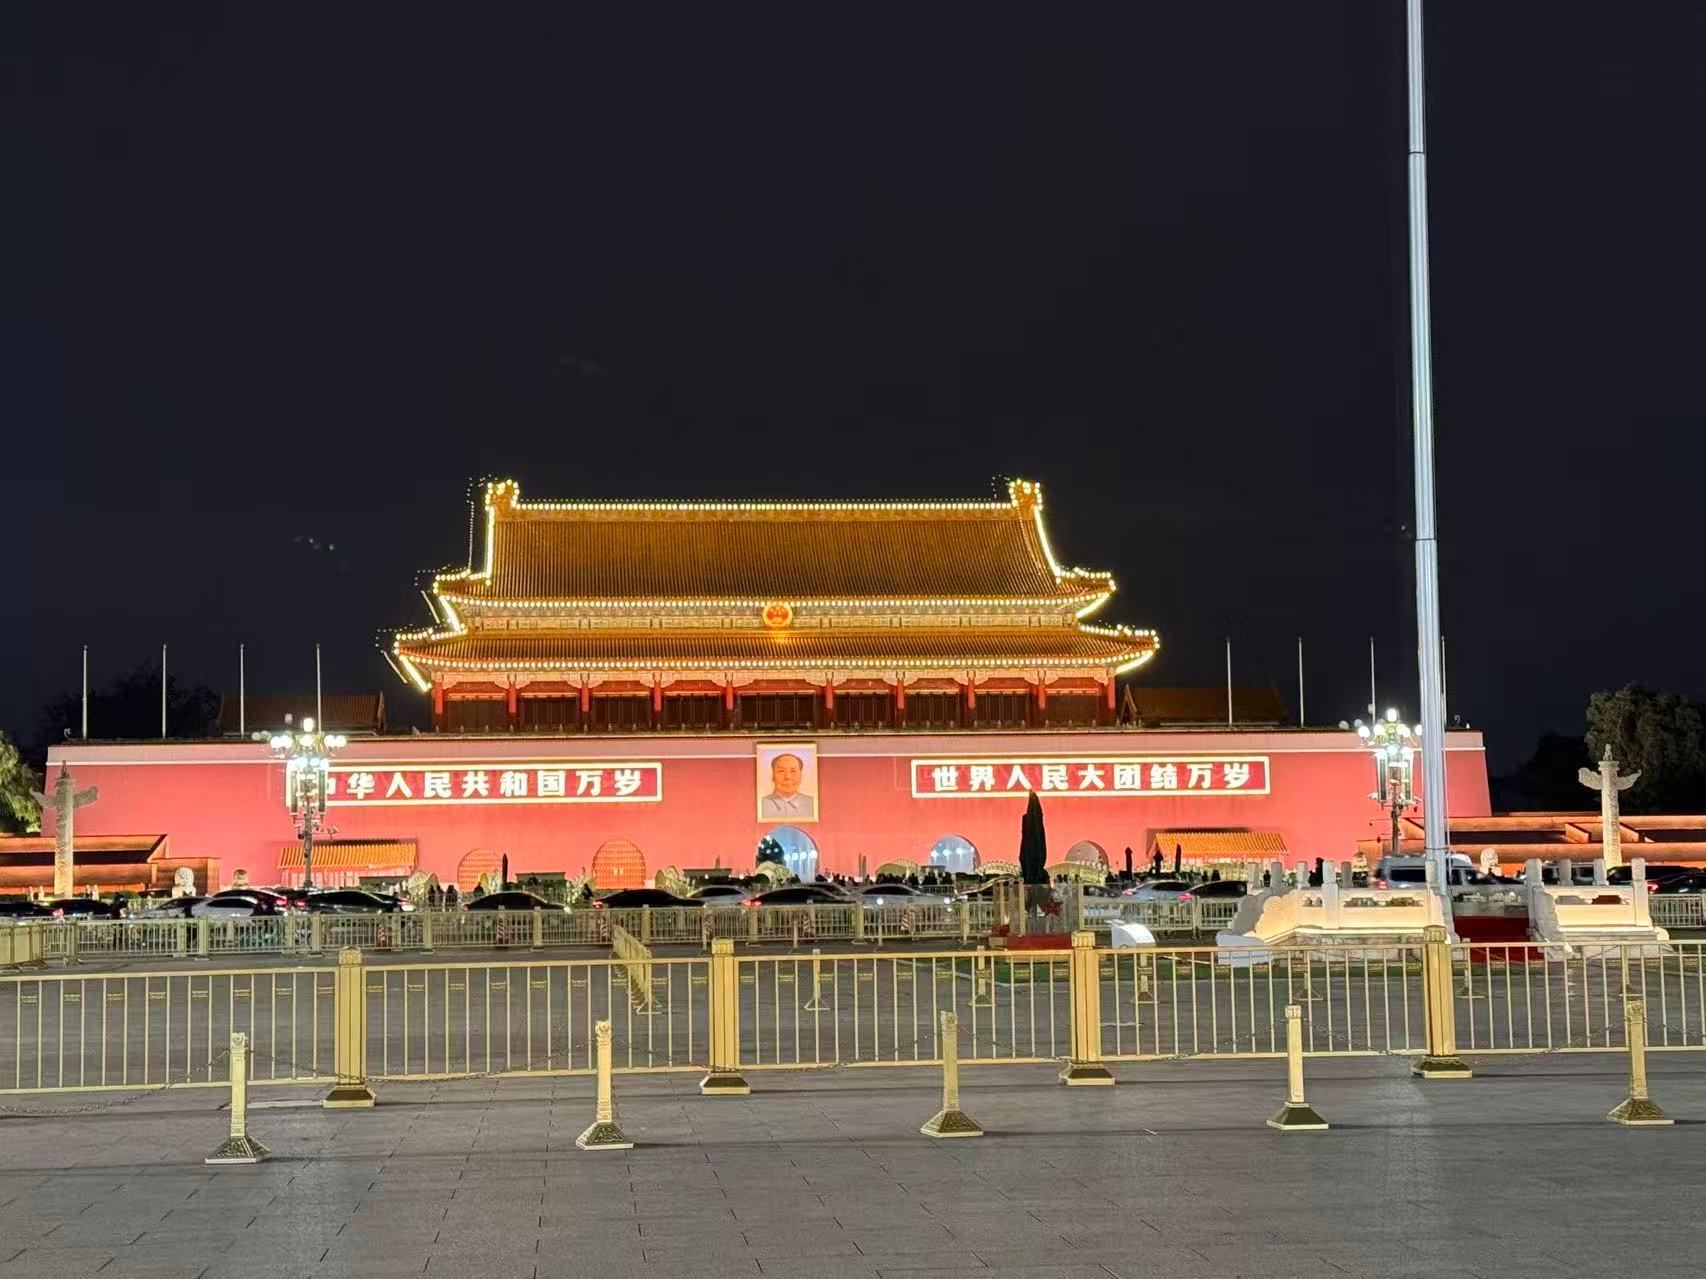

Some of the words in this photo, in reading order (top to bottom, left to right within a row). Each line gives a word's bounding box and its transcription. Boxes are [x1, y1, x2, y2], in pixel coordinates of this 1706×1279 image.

[932, 763, 1251, 791] 世界人民大团结万岁
